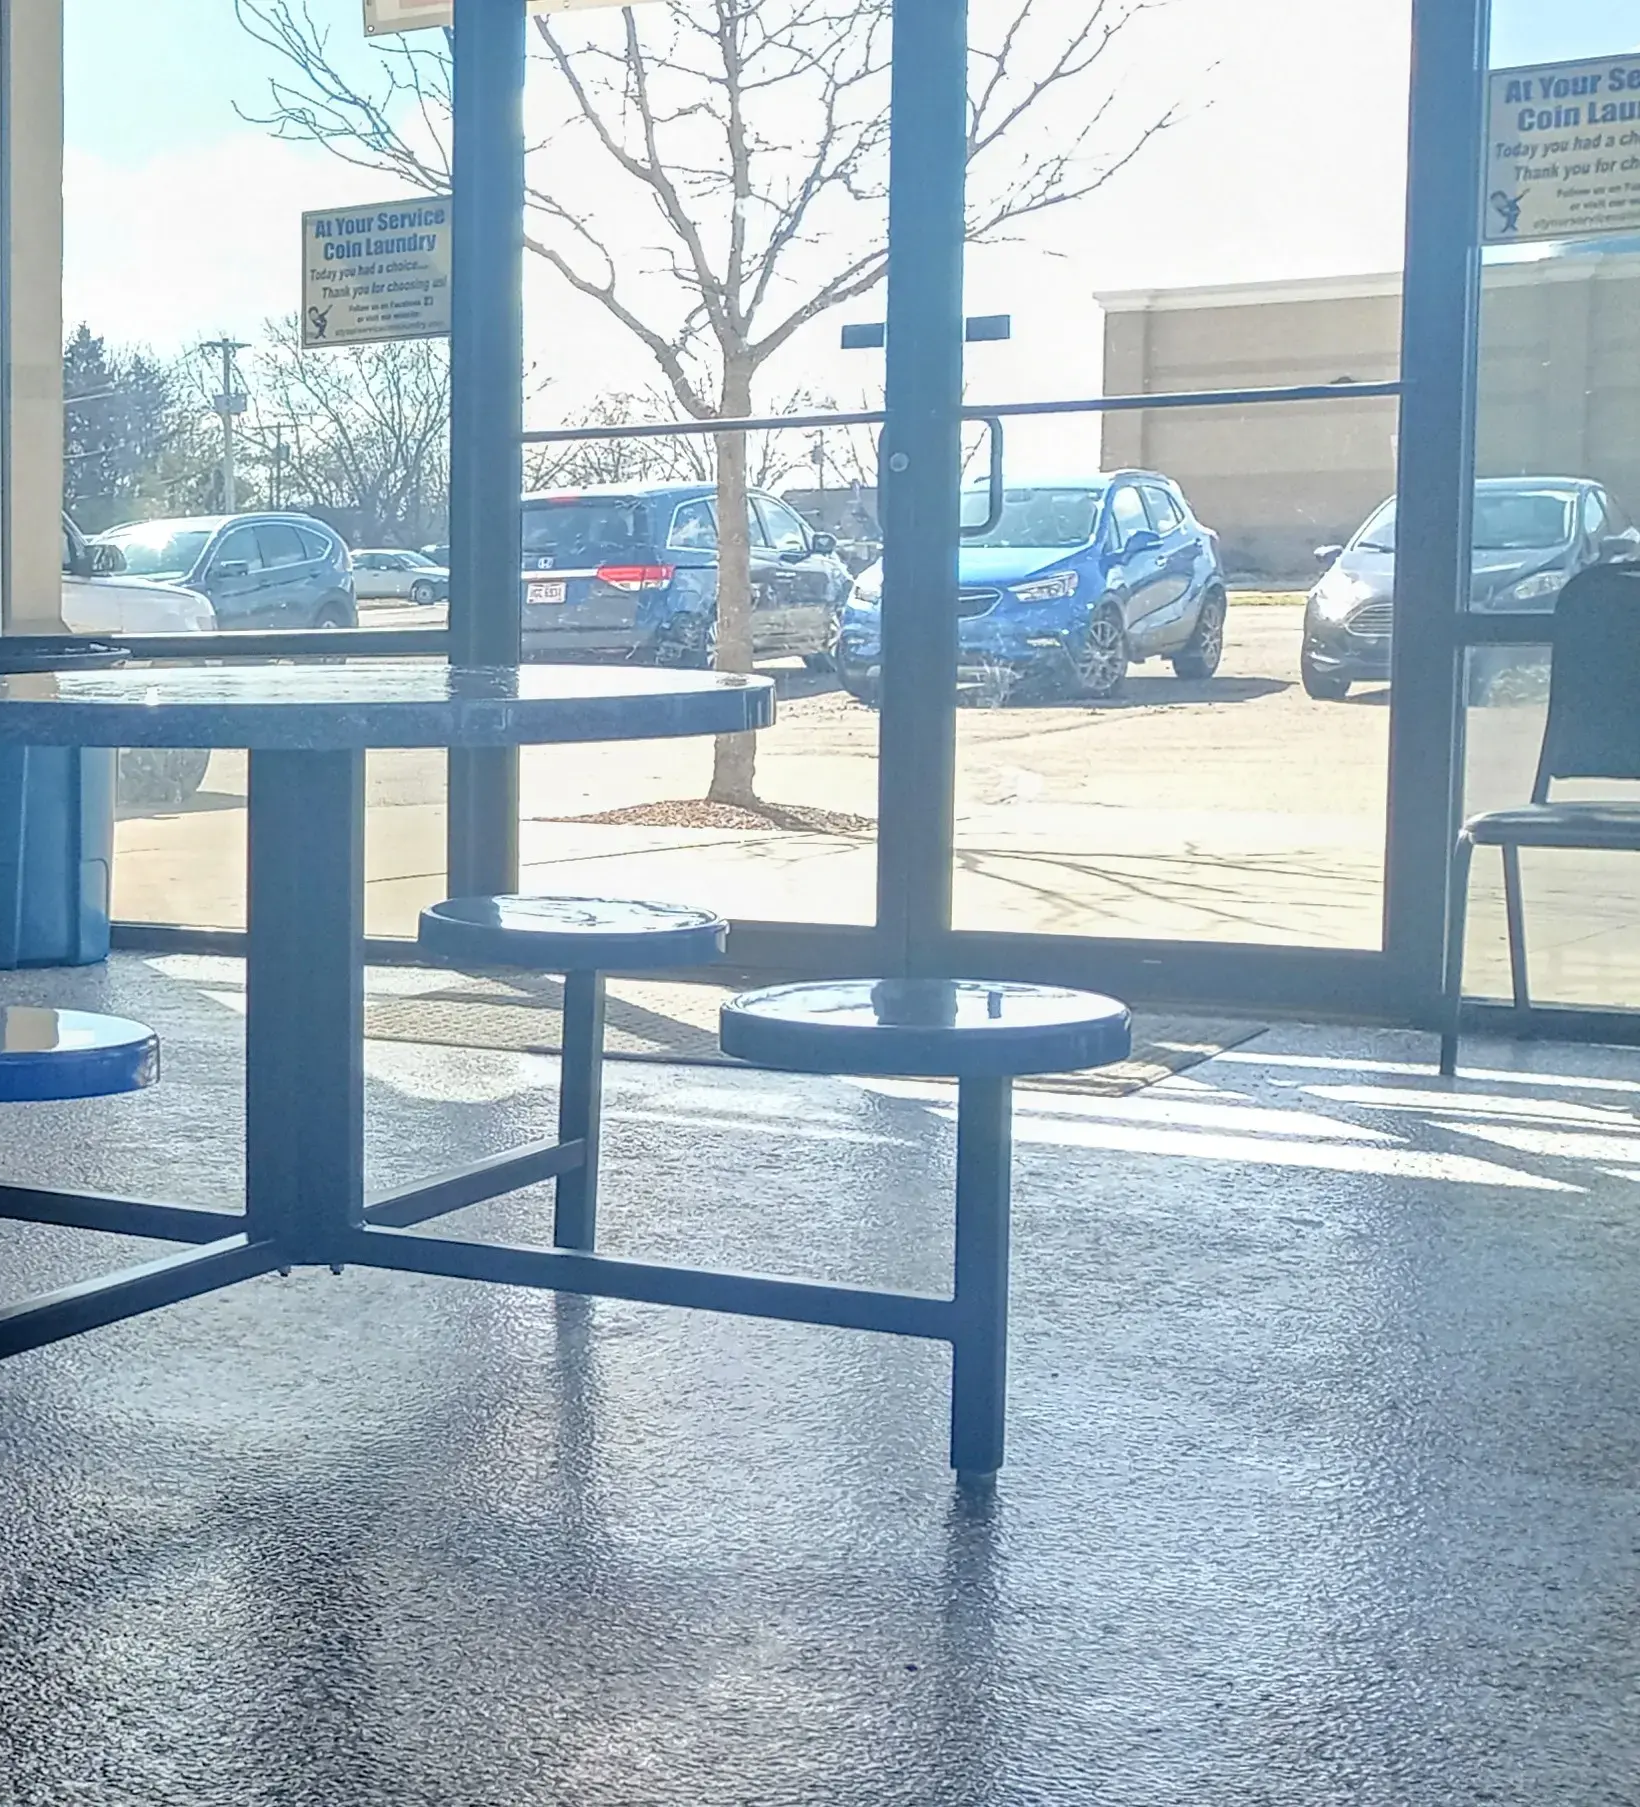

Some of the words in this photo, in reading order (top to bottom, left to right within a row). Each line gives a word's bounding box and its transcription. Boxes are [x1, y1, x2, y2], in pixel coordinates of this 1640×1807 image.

[1504, 80, 1532, 104] At
[1539, 74, 1602, 99] Your
[1517, 105, 1580, 132] Coin
[1496, 142, 1539, 160] Today
[1541, 140, 1569, 158] you
[1573, 134, 1602, 151] had
[1605, 136, 1615, 147] a
[1514, 162, 1559, 181] Thank
[1563, 163, 1591, 181] you
[1595, 157, 1618, 174] for
[315, 220, 332, 239] At
[335, 216, 374, 236] Your
[377, 207, 445, 231] Service
[324, 240, 362, 261] Coin
[366, 233, 437, 256] Laundry
[310, 268, 338, 282] Today
[339, 267, 356, 281] you
[358, 261, 375, 276] had
[377, 265, 384, 274] a
[322, 285, 351, 299] Thank
[352, 285, 370, 300] you
[371, 282, 384, 294] for
[387, 278, 430, 293] choosing
